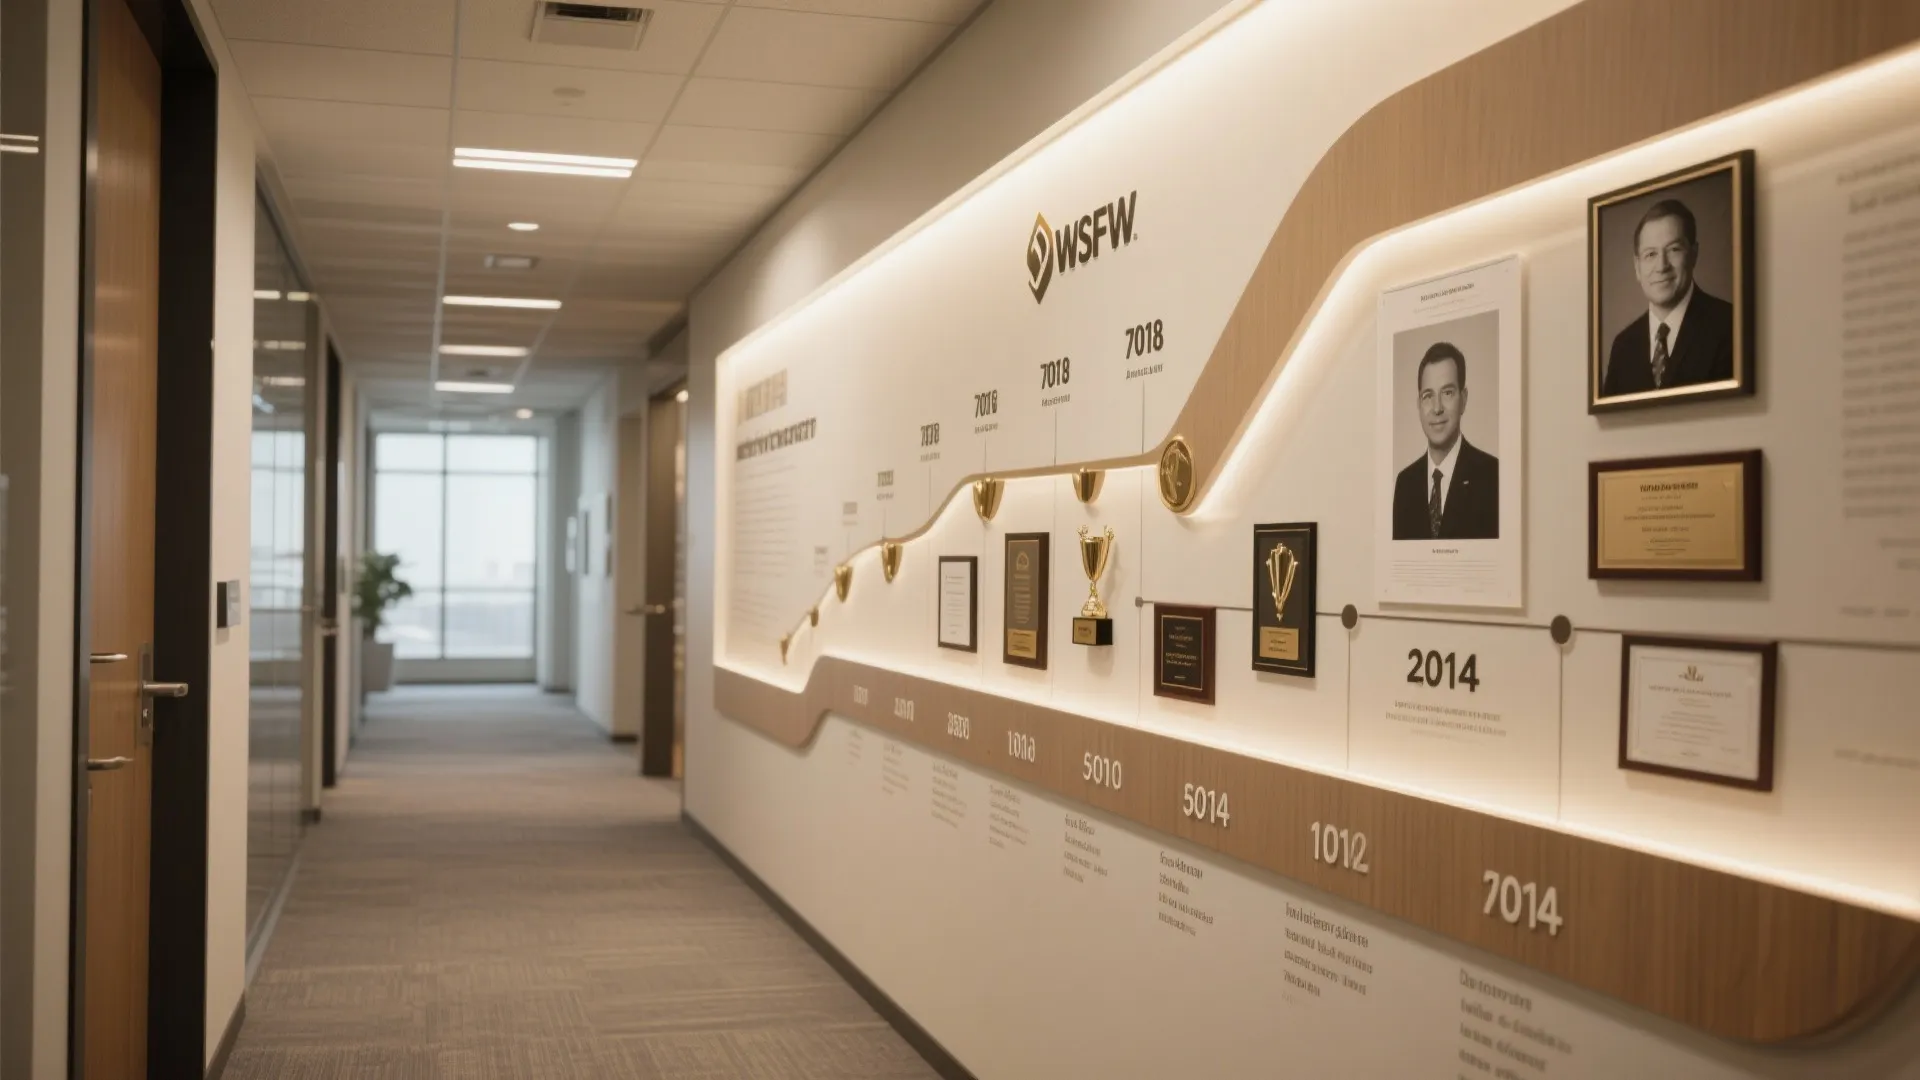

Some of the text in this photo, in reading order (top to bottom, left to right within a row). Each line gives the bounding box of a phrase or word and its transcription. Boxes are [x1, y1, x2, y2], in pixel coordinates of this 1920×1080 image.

[1125, 319, 1164, 360] 7018
[1040, 357, 1071, 390] 7018
[1407, 648, 1480, 693] 2014
[1082, 751, 1122, 790] 5010
[1182, 782, 1230, 828] 5014
[1310, 821, 1369, 873] 1012
[1483, 869, 1563, 936] 7014
